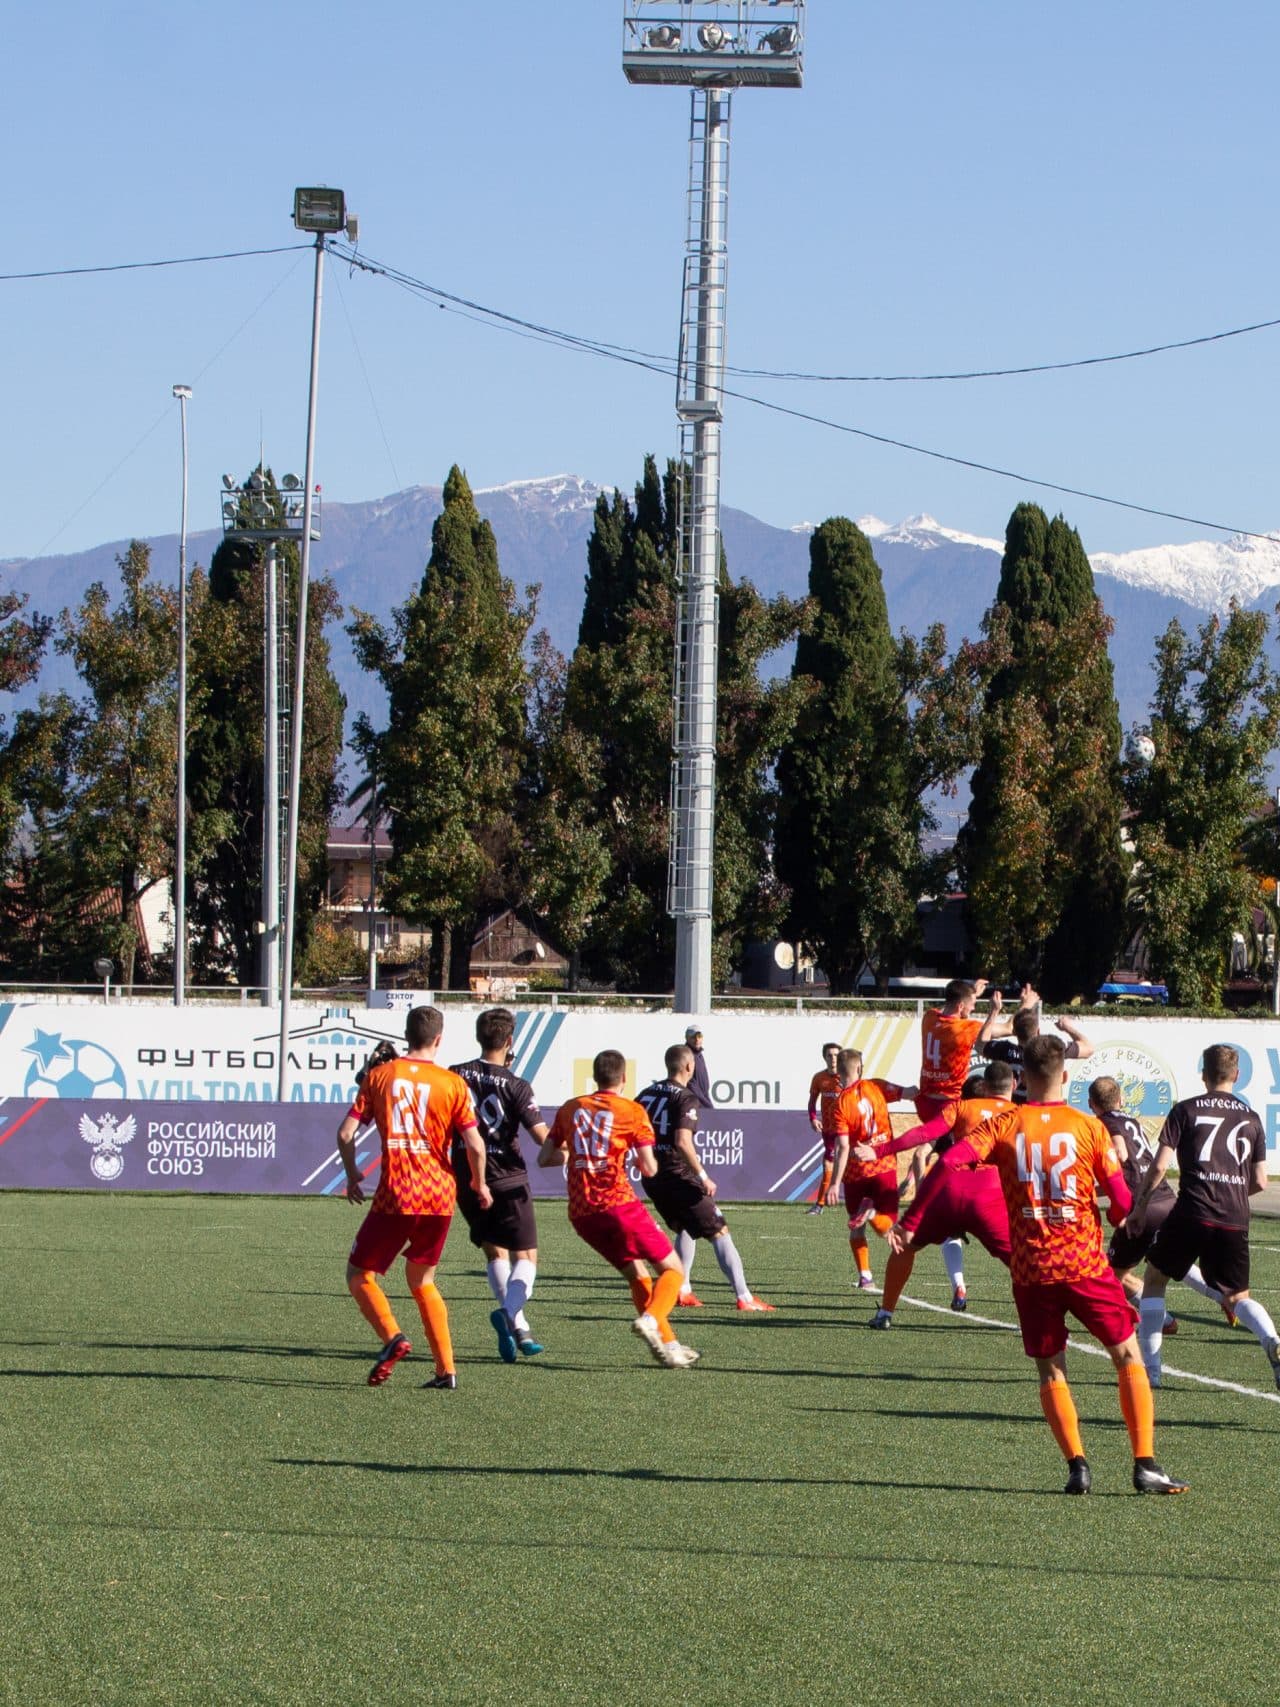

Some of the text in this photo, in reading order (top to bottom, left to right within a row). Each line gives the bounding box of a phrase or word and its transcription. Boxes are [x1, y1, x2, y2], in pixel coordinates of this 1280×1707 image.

[385, 992, 414, 1000] СЕКТОР
[138, 1047, 410, 1071] ФУТБОЛЬН
[392, 1078, 432, 1136] 21
[472, 1088, 505, 1136] 9
[147, 1120, 276, 1141] РОССИЙСКИЙ
[1194, 1115, 1252, 1166] 76
[147, 1139, 276, 1159] ФУТБОЛЬНЫЙ
[147, 1158, 204, 1175] СОЮЗ
[1015, 1131, 1078, 1200] 42
[1021, 1205, 1076, 1221] SEUS
